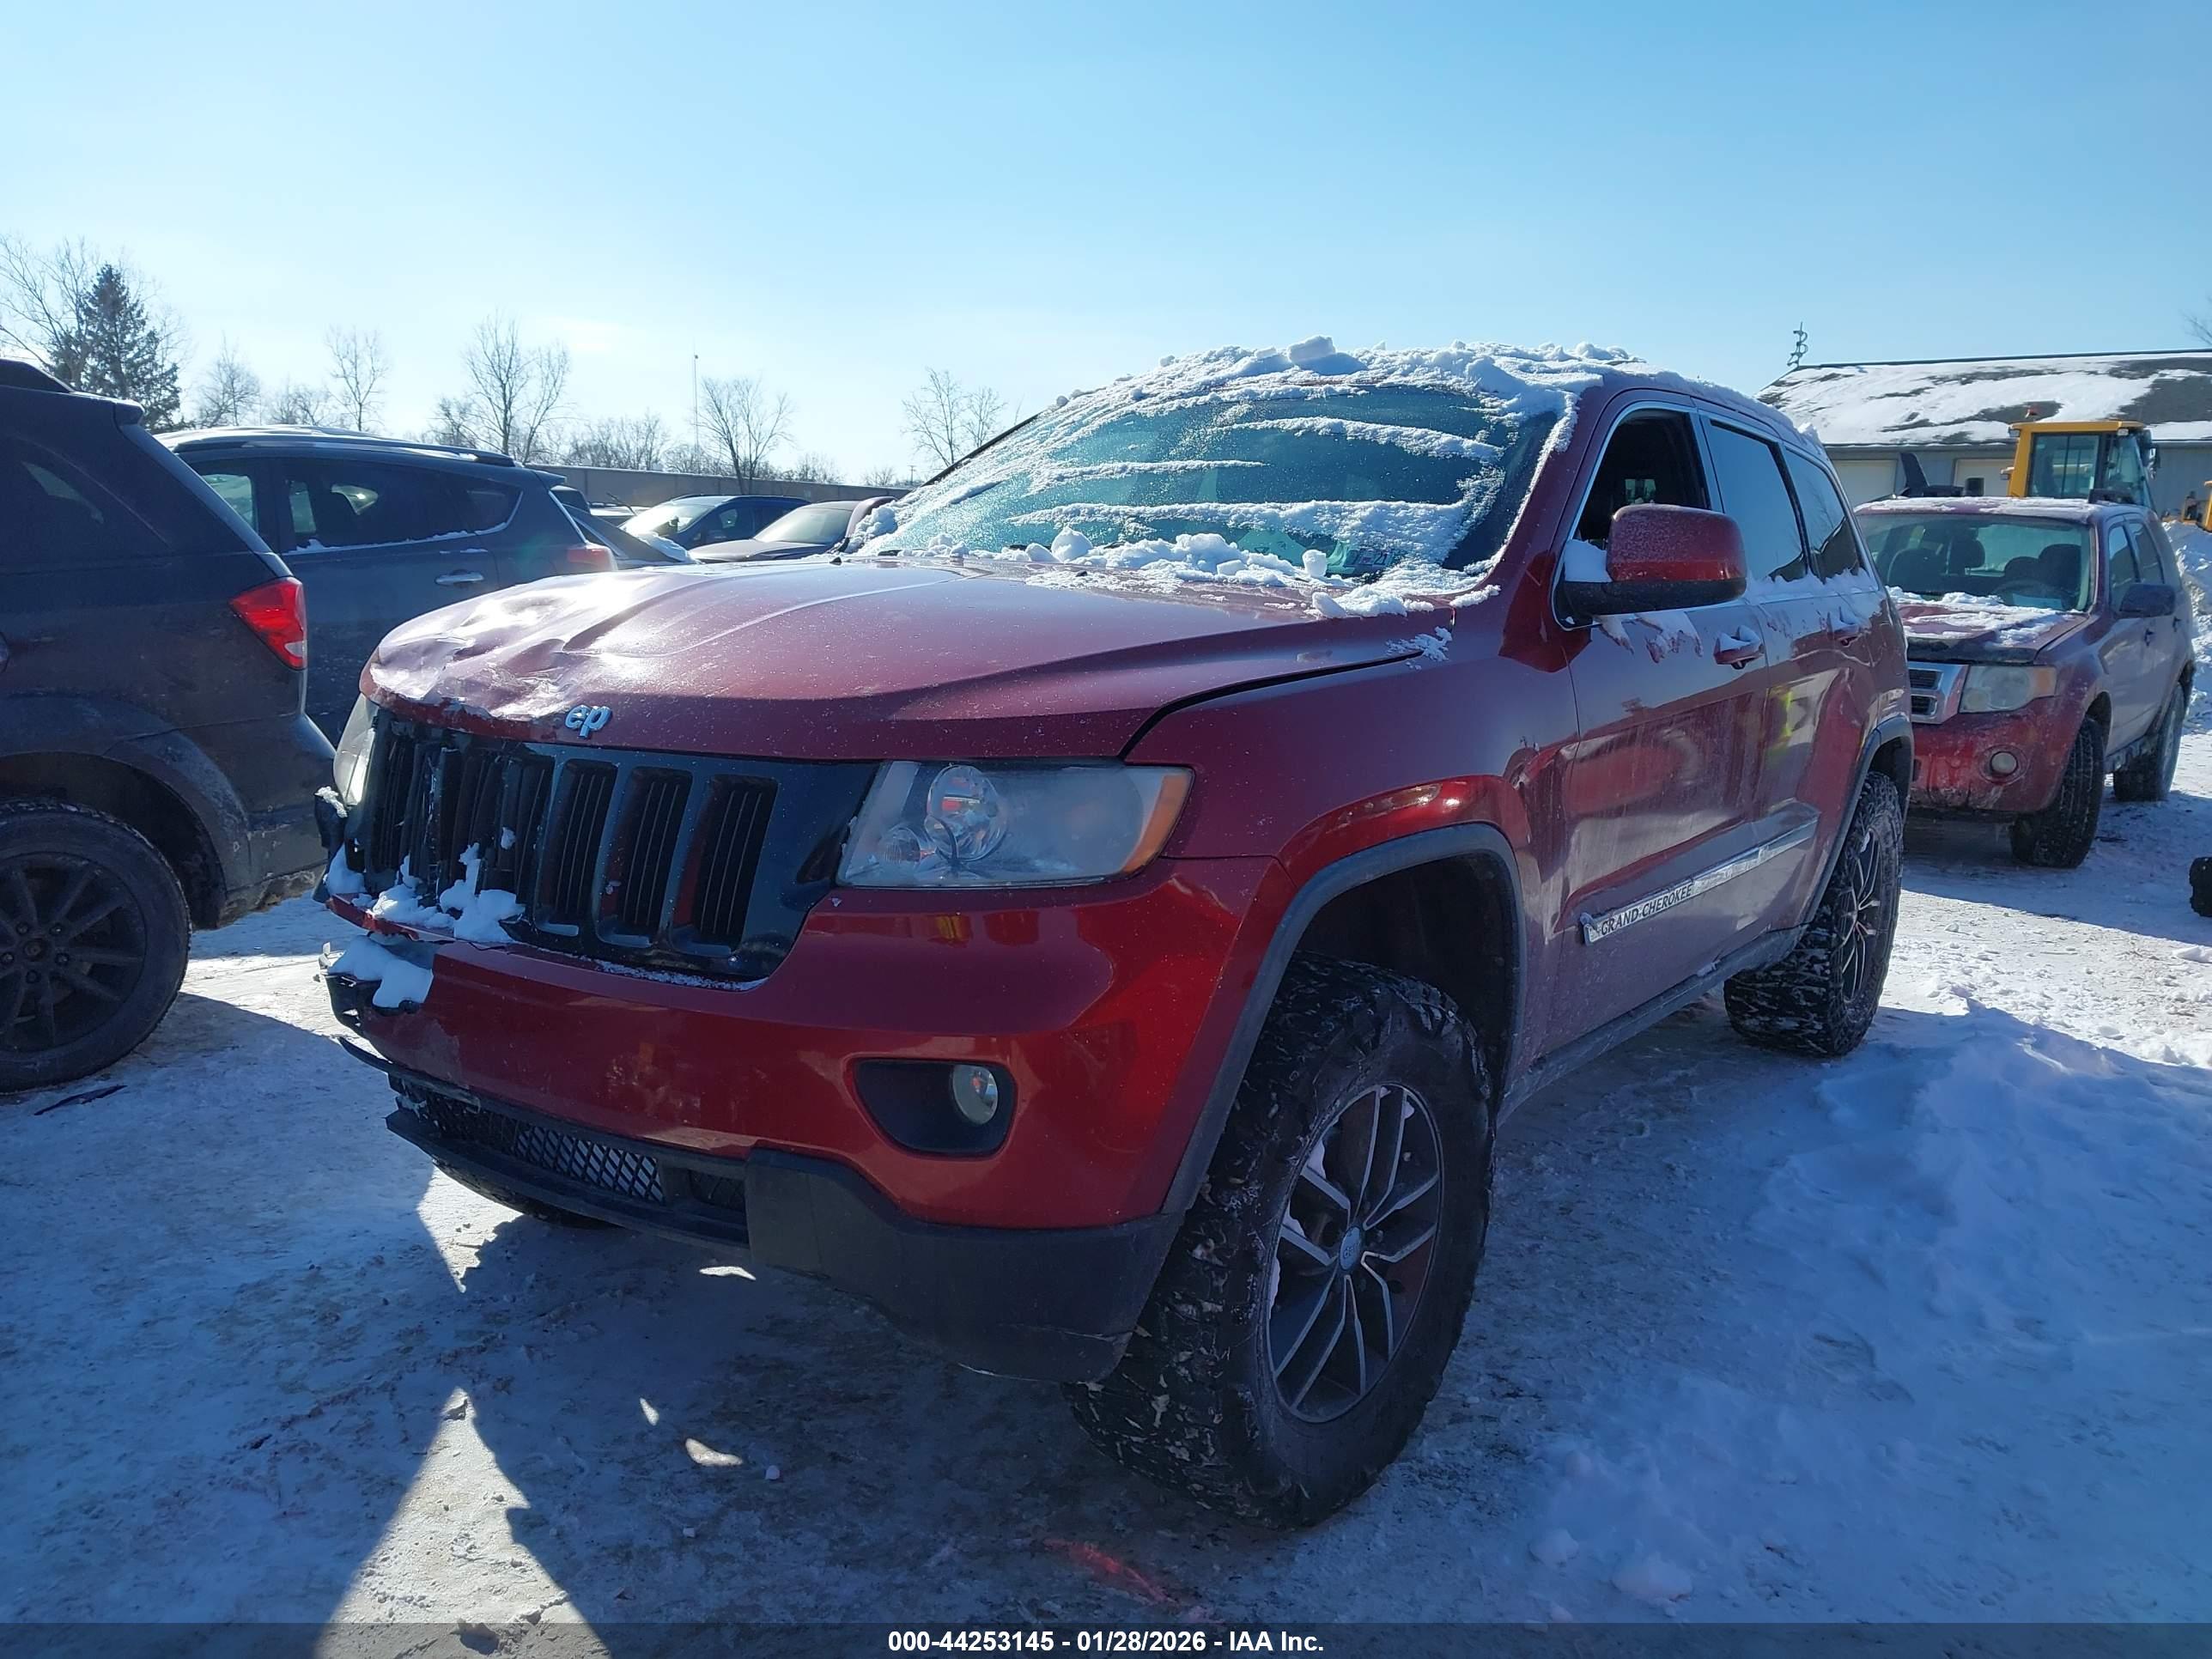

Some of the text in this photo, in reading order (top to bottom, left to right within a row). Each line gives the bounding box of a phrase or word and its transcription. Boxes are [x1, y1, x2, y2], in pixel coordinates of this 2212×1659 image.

[565, 704, 612, 738] ep
[1601, 884, 1693, 936] GRAND CHEROKEE
